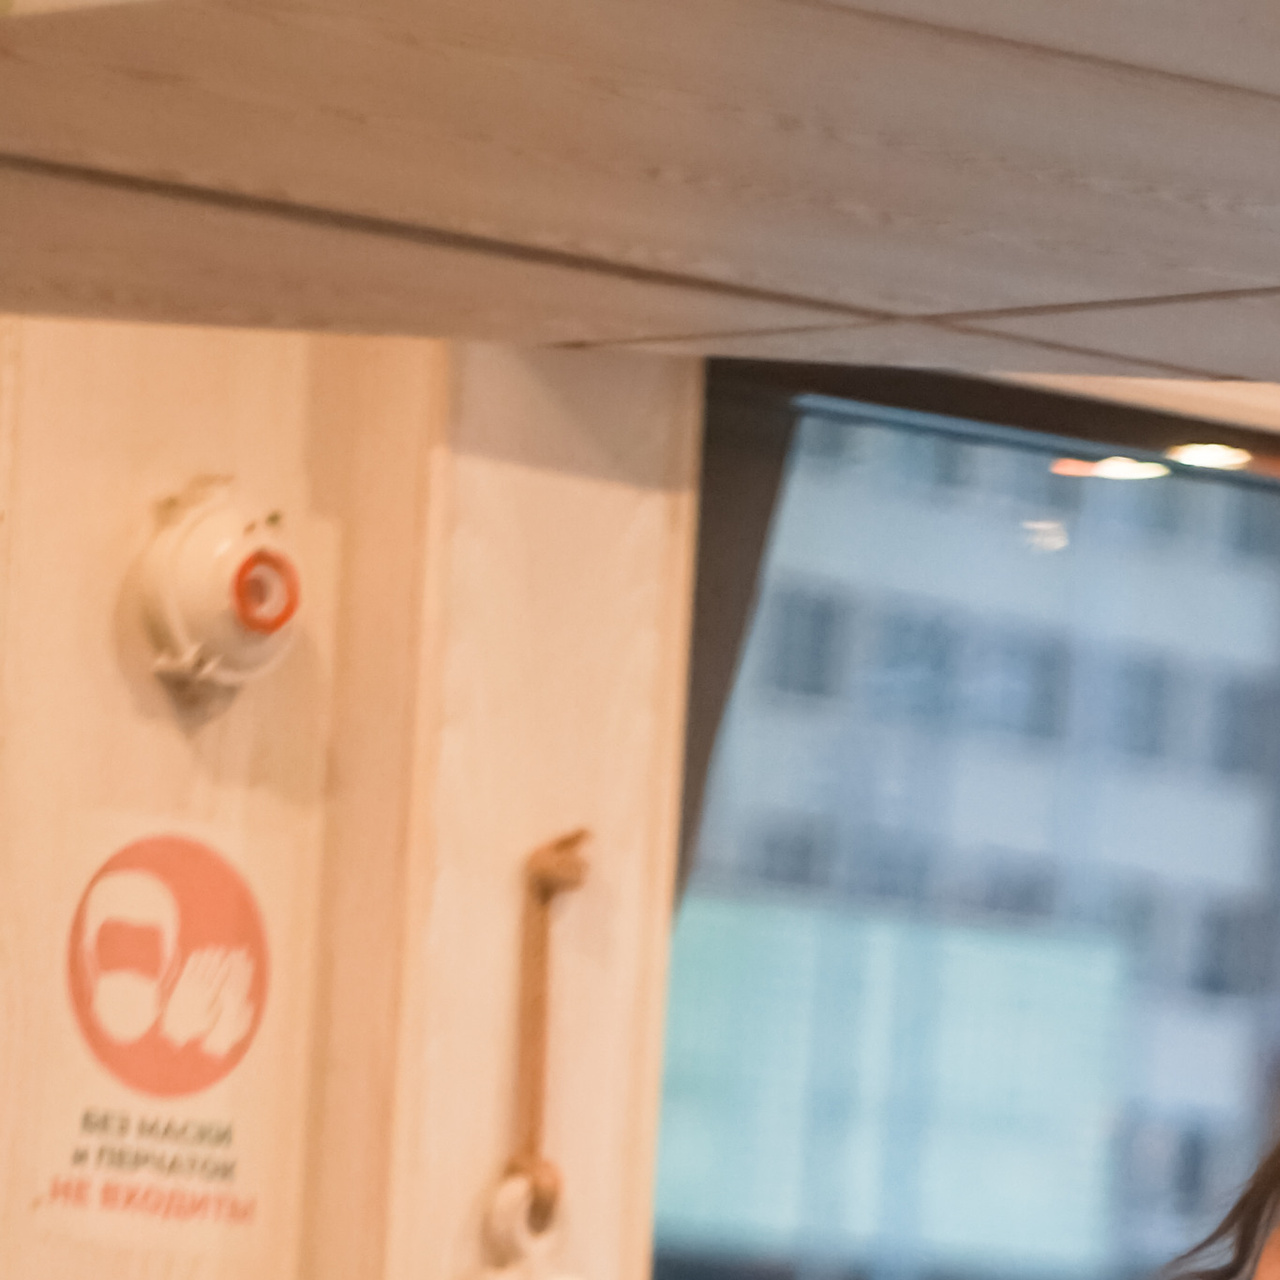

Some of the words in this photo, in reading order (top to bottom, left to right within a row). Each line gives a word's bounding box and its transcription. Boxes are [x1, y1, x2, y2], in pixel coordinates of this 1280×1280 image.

[82, 1108, 130, 1136] БЕЗ
[138, 1114, 233, 1146] МАСКИ
[97, 1146, 237, 1181] ПЕРЧАТОК
[50, 1176, 91, 1208] НЕ
